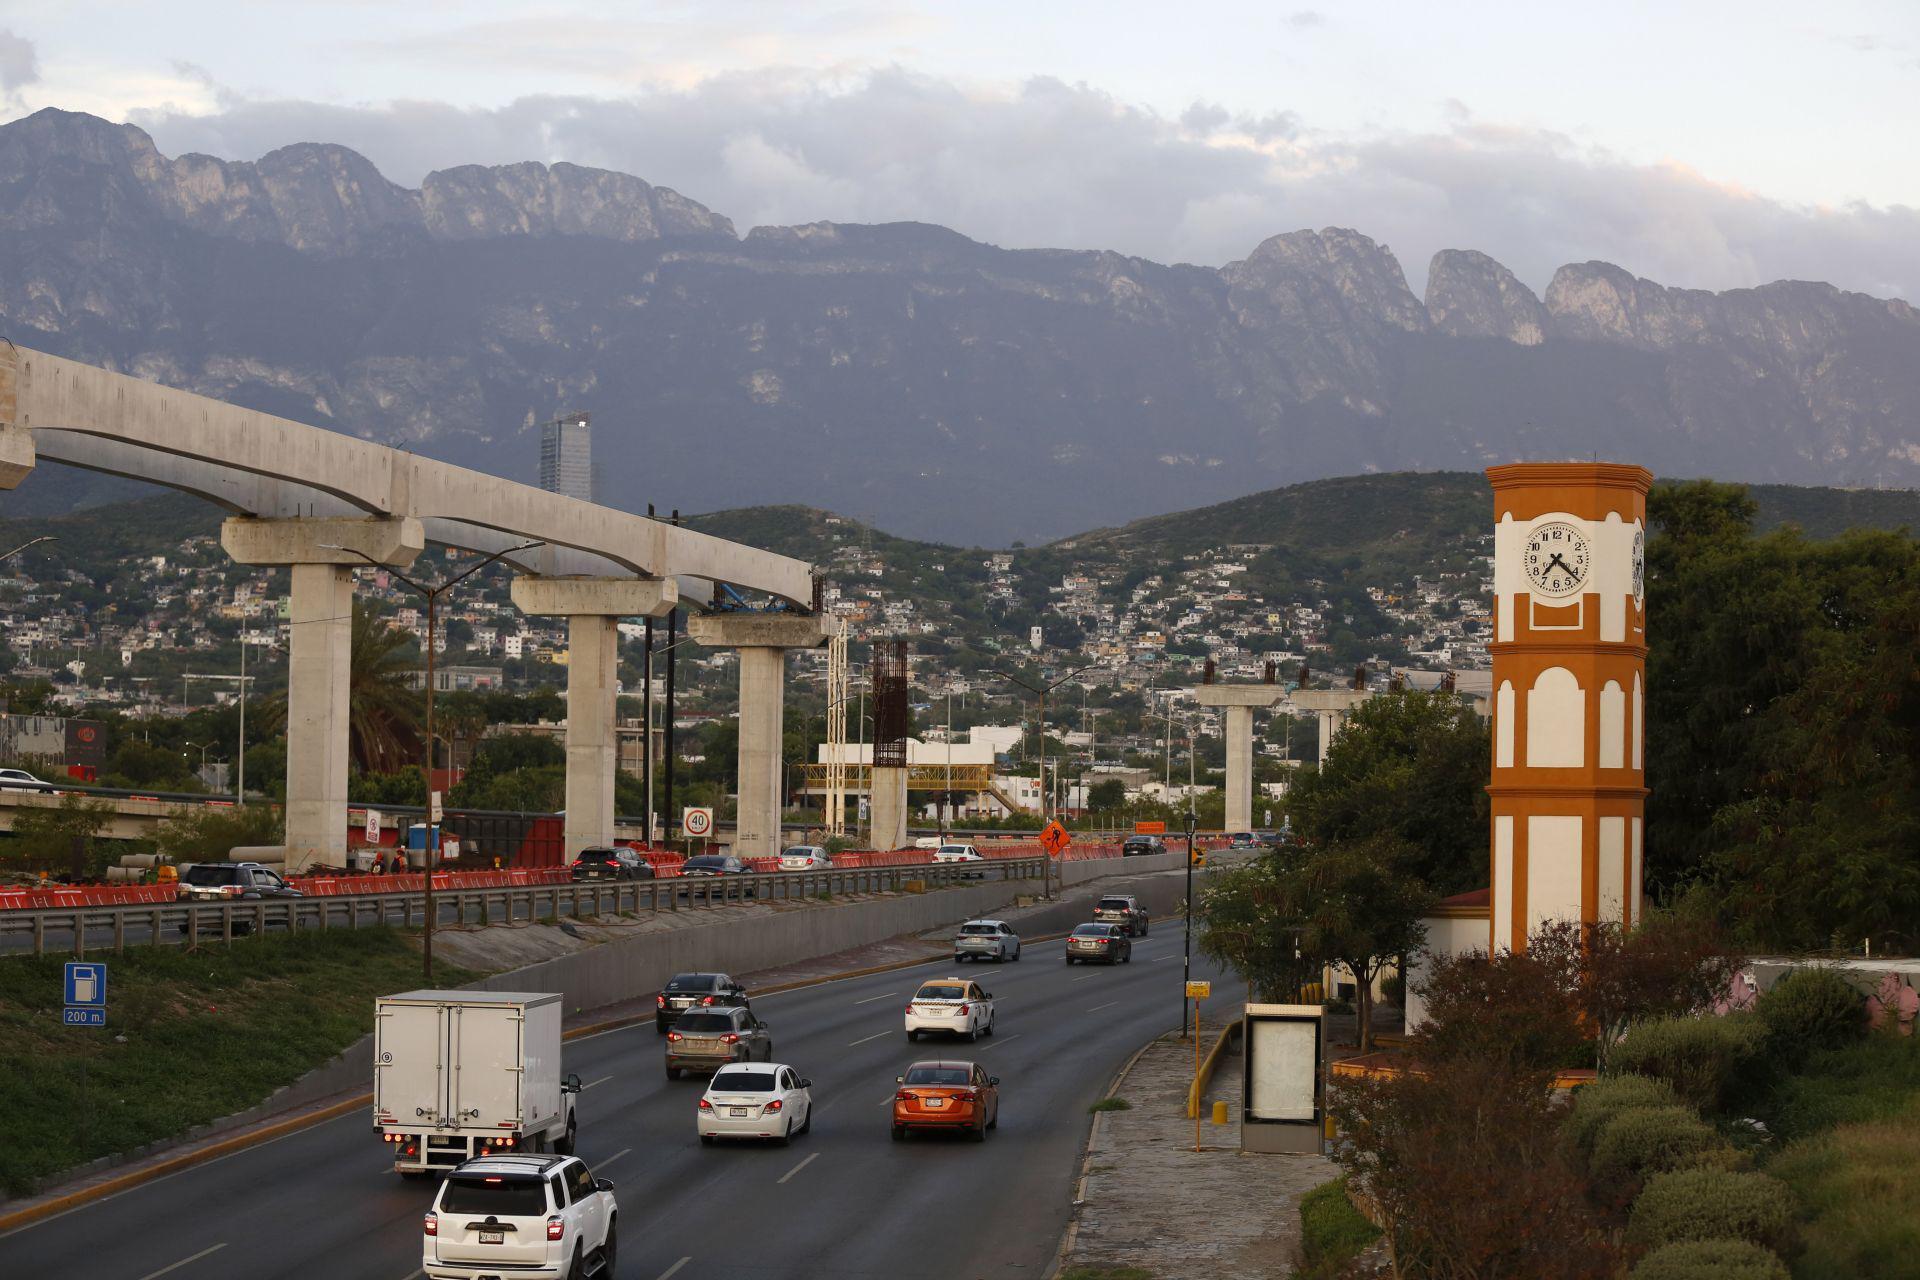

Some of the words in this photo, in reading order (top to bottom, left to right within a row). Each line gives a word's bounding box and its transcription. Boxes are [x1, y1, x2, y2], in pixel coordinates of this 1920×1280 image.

[1542, 533, 1549, 541] 11
[1553, 531, 1562, 539] 12
[1567, 534, 1571, 542] 1
[1531, 543, 1540, 551] 10
[1575, 542, 1581, 551] 2
[1530, 555, 1537, 564] 9
[1577, 556, 1583, 564] 3
[1533, 567, 1539, 576] 8
[1572, 567, 1579, 576] 4
[1541, 576, 1548, 586] 7
[1553, 580, 1560, 588] 6
[1565, 577, 1571, 586] 5
[692, 815, 704, 825] 40
[67, 1011, 87, 1022] 200
[91, 1013, 103, 1022] m.
